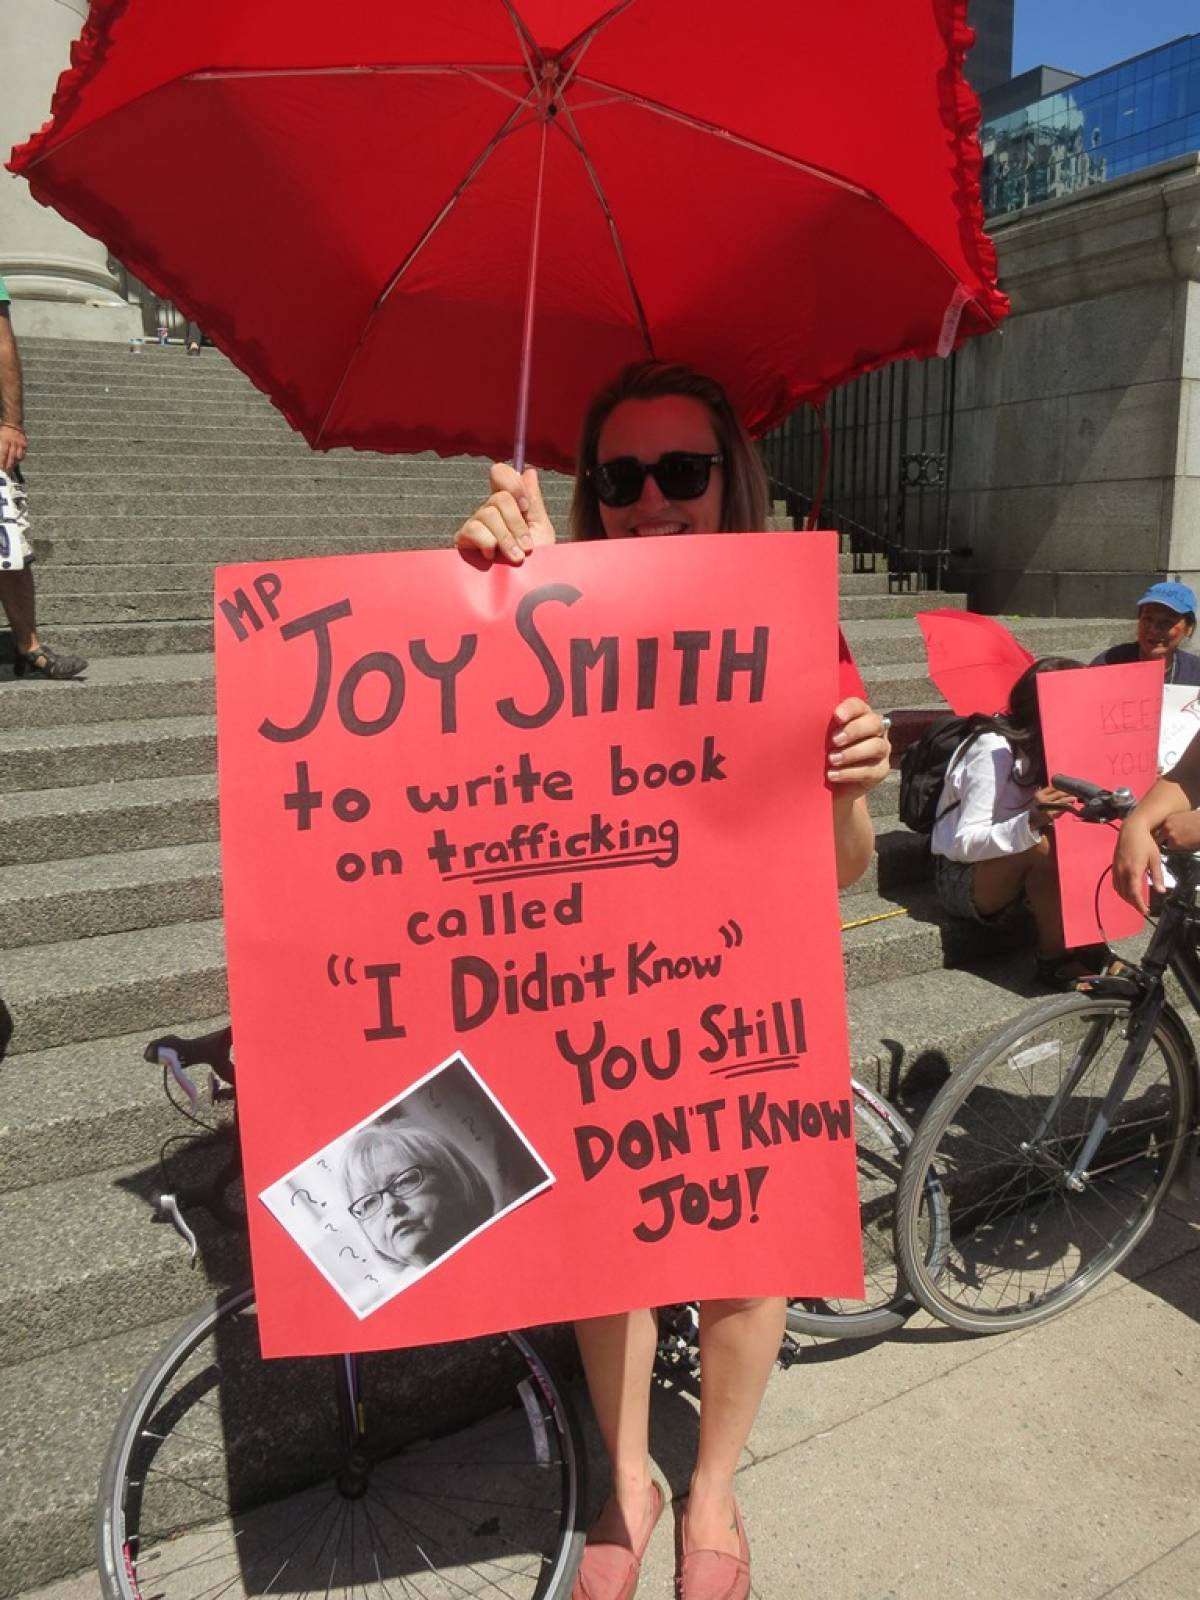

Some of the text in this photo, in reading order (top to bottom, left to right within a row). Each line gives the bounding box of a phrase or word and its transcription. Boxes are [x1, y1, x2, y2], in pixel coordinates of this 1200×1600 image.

[219, 573, 282, 642] MP
[259, 582, 770, 743] JOY SMITH
[284, 735, 728, 831] to write book
[336, 814, 680, 883] on trafficking
[407, 882, 583, 945] called
[451, 949, 615, 1034] Didn't
[699, 997, 808, 1064] Still
[575, 1098, 726, 1183] DON'T
[738, 1091, 853, 1151] KNOW
